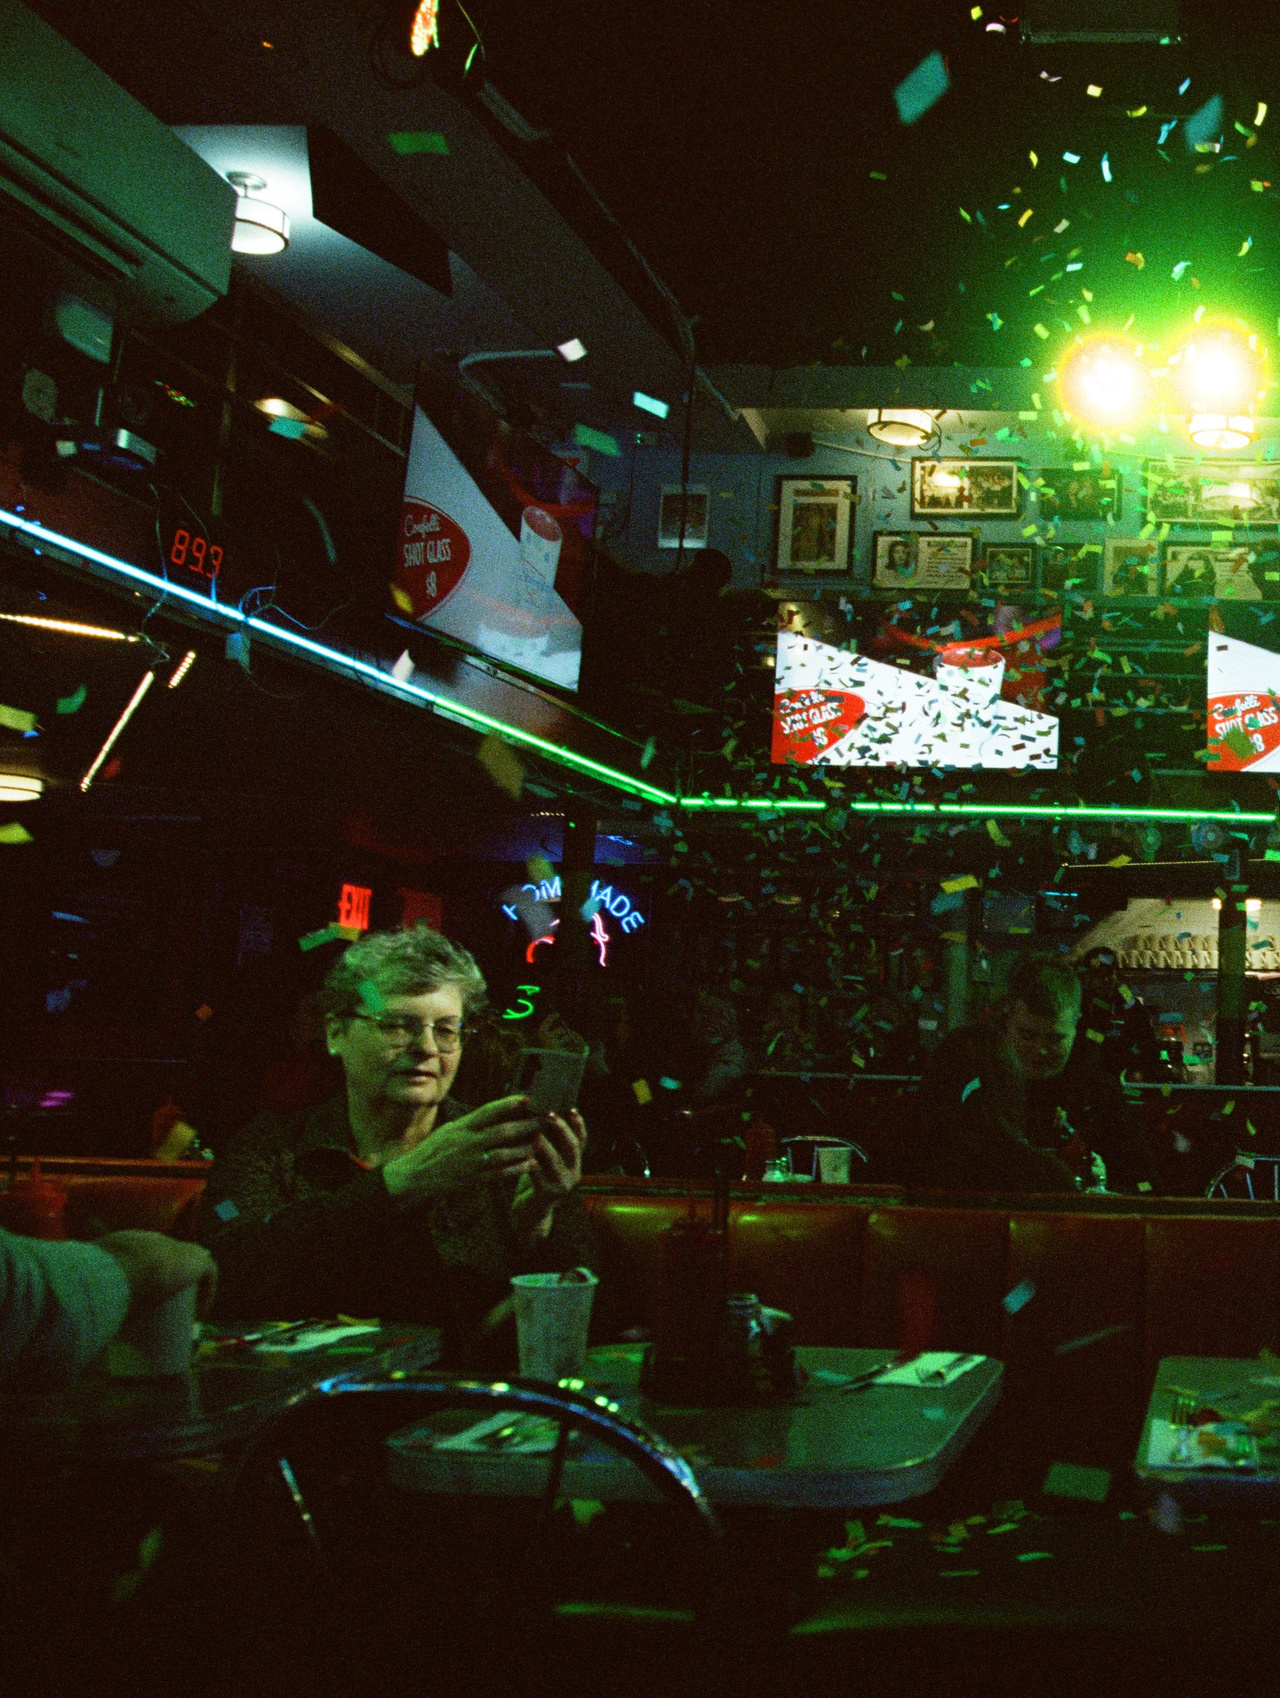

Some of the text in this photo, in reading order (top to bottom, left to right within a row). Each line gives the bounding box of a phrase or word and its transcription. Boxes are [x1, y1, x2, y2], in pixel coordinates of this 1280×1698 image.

[403, 538, 452, 568] SHOT GLASS
[425, 571, 437, 598] $8
[339, 883, 372, 930] EXIT
